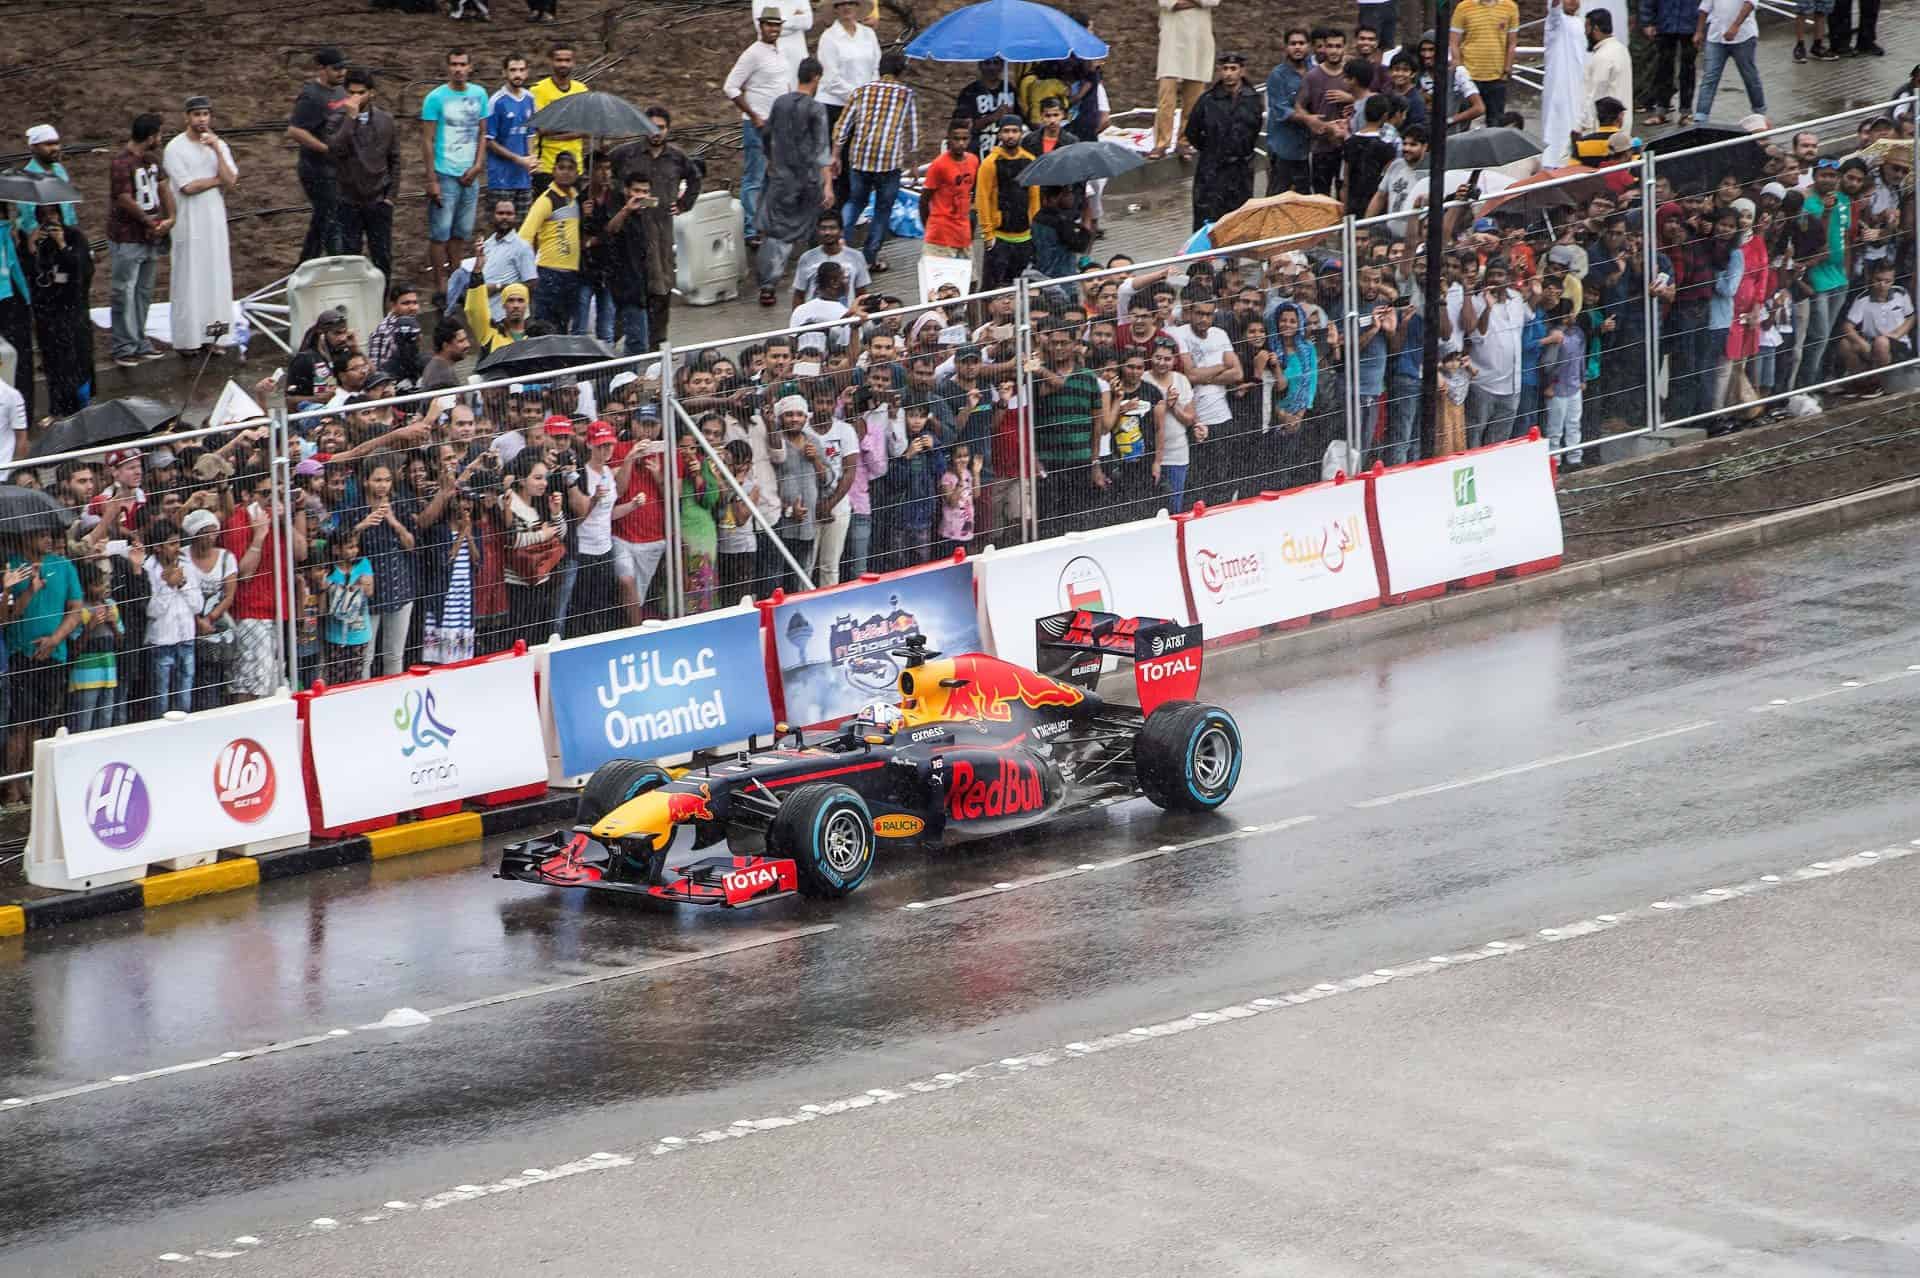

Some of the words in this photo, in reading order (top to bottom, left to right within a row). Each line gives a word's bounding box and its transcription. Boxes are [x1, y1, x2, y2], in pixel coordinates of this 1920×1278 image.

[1195, 549, 1258, 593] Times
[1165, 634, 1186, 649] AT&T
[597, 648, 717, 709] عمانتل
[1139, 656, 1197, 683] TOTAL
[605, 689, 727, 748] Omantel
[911, 726, 945, 742] exness
[88, 767, 138, 825] Hi
[882, 820, 918, 832] RAUCH
[722, 866, 786, 891] TOTAL
